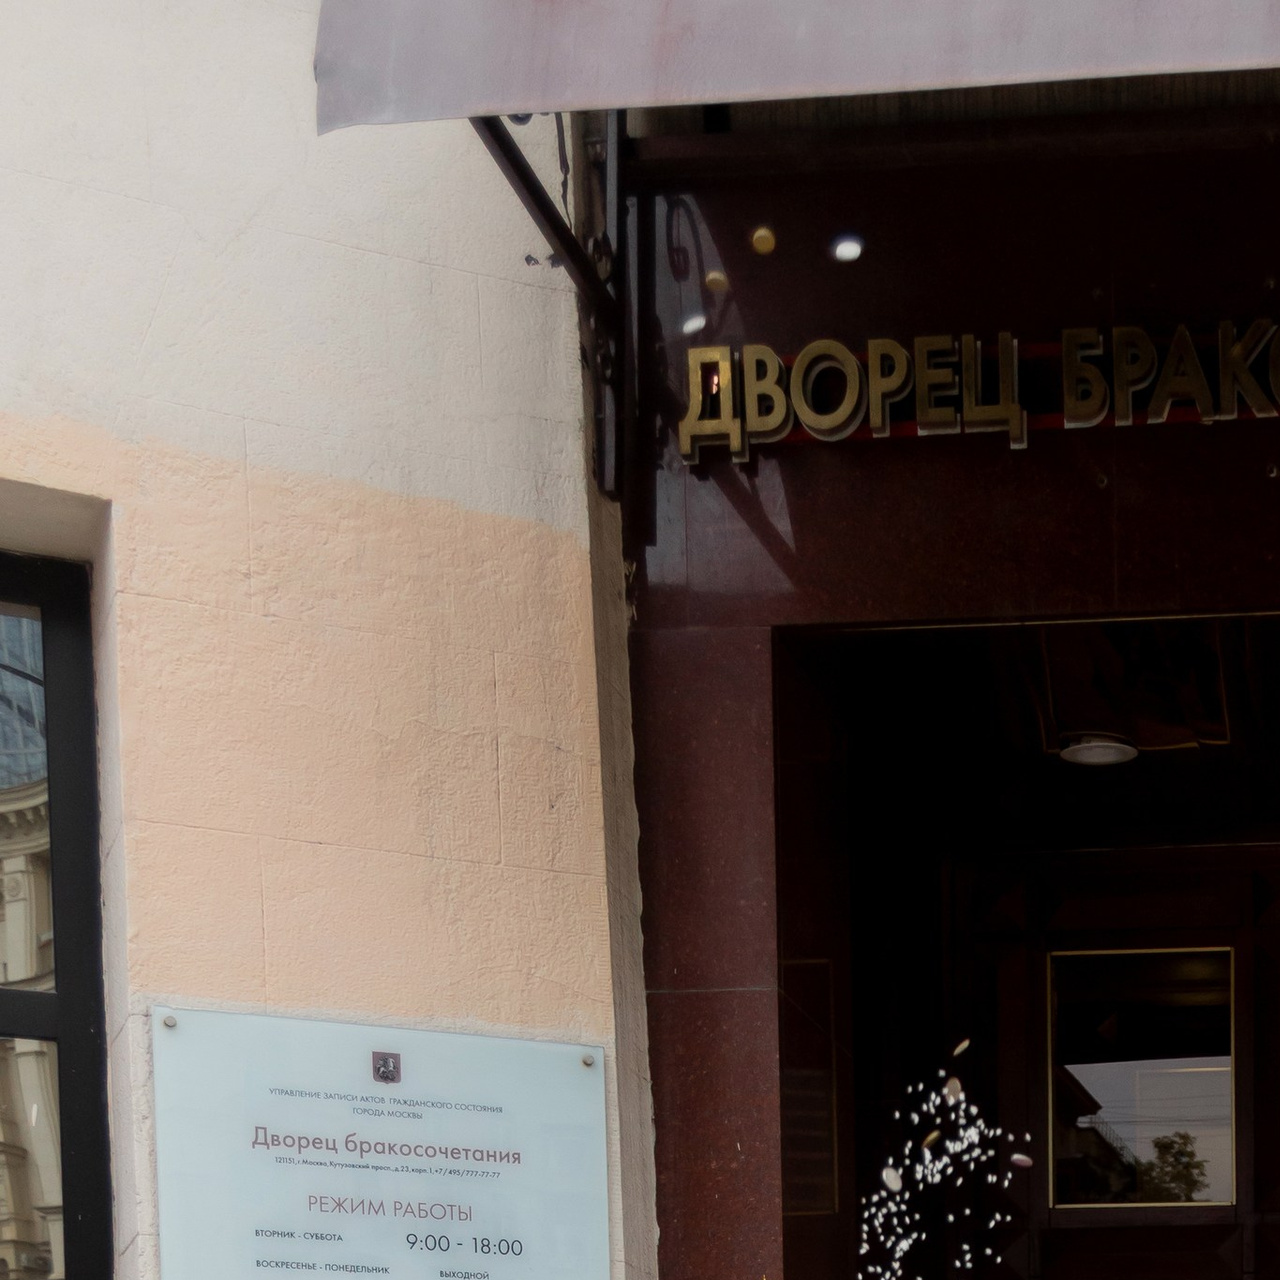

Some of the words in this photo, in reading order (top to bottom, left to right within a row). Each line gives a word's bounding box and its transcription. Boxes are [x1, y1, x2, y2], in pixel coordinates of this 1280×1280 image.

[679, 331, 1027, 463] ДВОРЕЦ
[268, 1087, 322, 1100] УПРАВЛЕНИЕ
[323, 1091, 358, 1103] ЗАПИСИ
[359, 1095, 386, 1105] АКТОВ
[389, 1097, 453, 1110] ГРАЖДАНСКОГО
[454, 1103, 503, 1114] СОСТОЯНИЯ
[352, 1107, 387, 1118] ГОРОДА
[387, 1110, 423, 1120] МОСКВЫ
[251, 1126, 338, 1154] Дворец
[344, 1132, 522, 1165] бракосочетания
[308, 1195, 386, 1217] РЕЖИМ
[393, 1200, 473, 1222] РАБОТЫ
[255, 1229, 296, 1239] ВТОРНИК
[303, 1232, 344, 1242] СУББОТА
[406, 1233, 451, 1252] 9:00
[472, 1237, 523, 1256] 18:00
[255, 1259, 317, 1271] ВОСКРЕСЕНЬЕ
[324, 1263, 390, 1274] ПОНЕДЕЛЬНИК
[439, 1270, 490, 1280] ВЫХОДНОЙ
